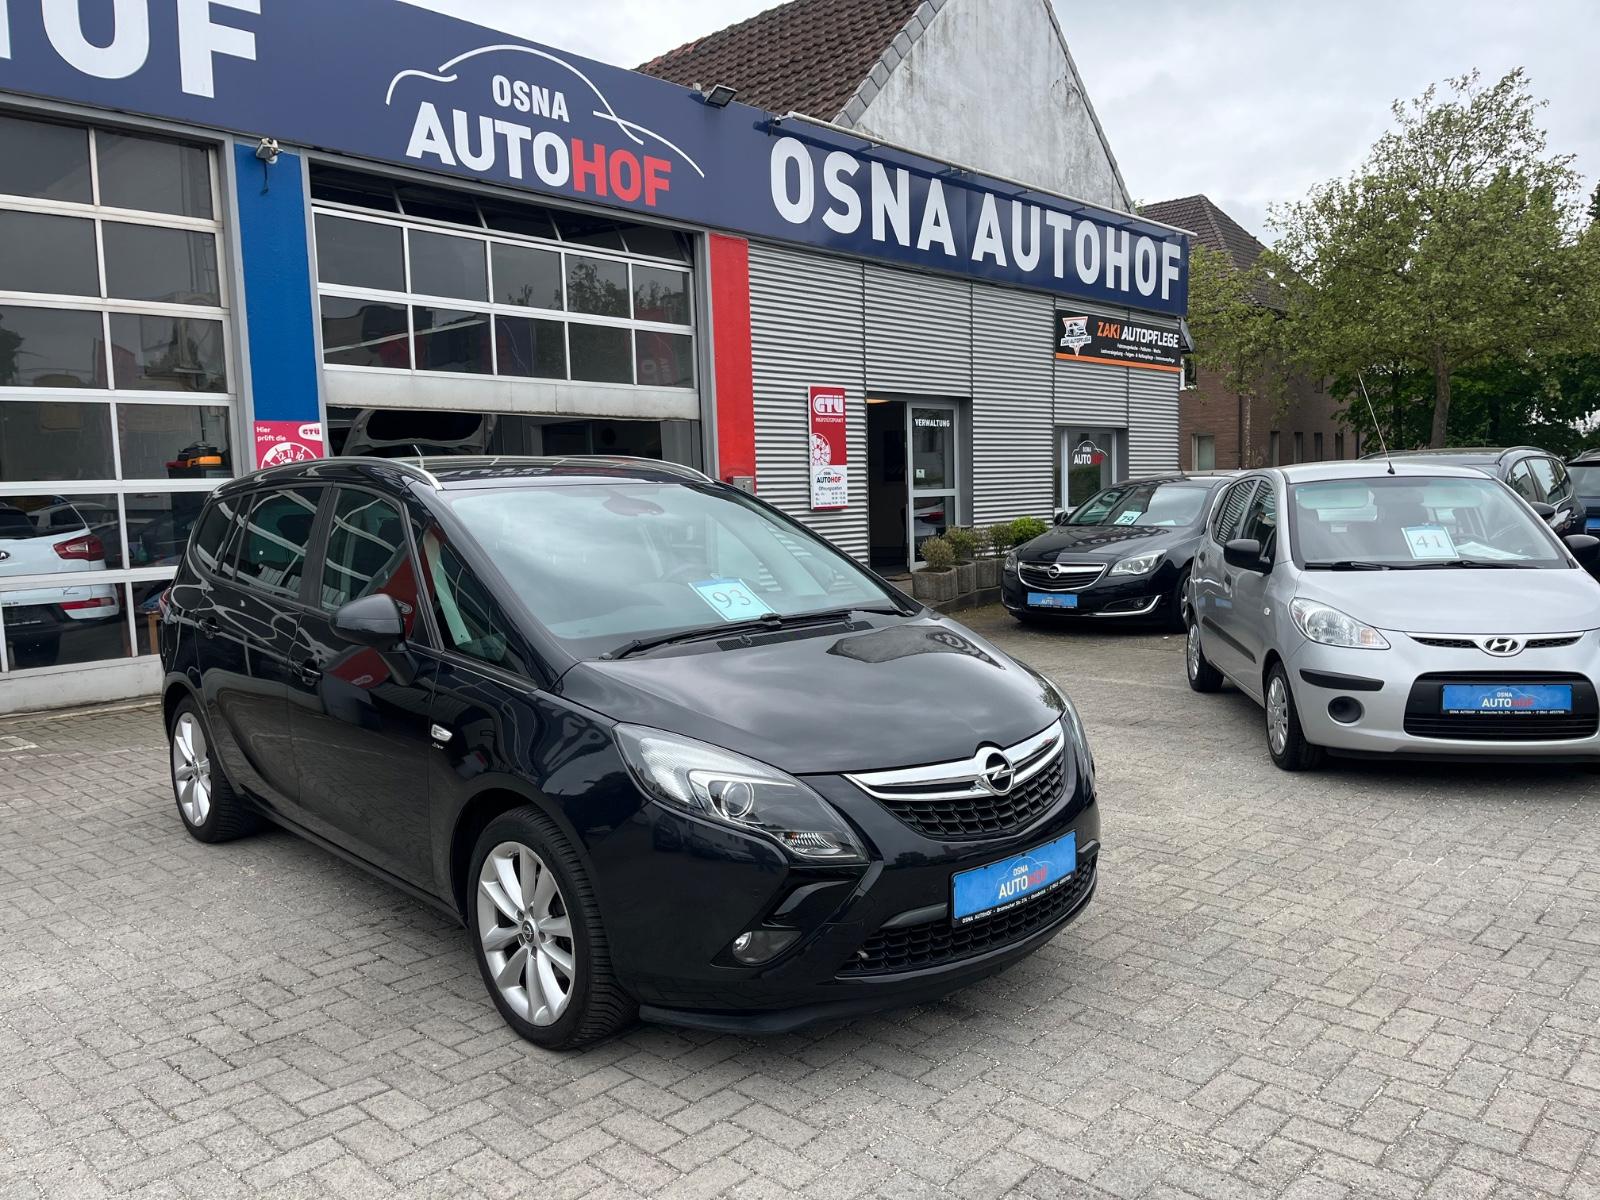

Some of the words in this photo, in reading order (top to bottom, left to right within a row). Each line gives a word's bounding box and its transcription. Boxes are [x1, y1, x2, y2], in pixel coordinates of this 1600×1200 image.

[0, 0, 262, 98] OF
[491, 74, 571, 123] OSNA
[405, 101, 673, 207] AUTOHOF
[770, 136, 958, 257] OSNA
[971, 192, 1181, 300] AUTOHOF
[1121, 326, 1179, 347] AUTOPFLEGE
[914, 418, 950, 427] VERWALTUNG
[276, 452, 286, 461] 12
[287, 450, 294, 458] 11
[295, 451, 305, 461] 10
[816, 476, 842, 484] AUTOHOF
[1122, 515, 1134, 523] 79
[1416, 535, 1442, 548] 41
[712, 587, 751, 609] 93
[998, 863, 1048, 899] AUTOHOF
[1012, 864, 1029, 877] OSNA
